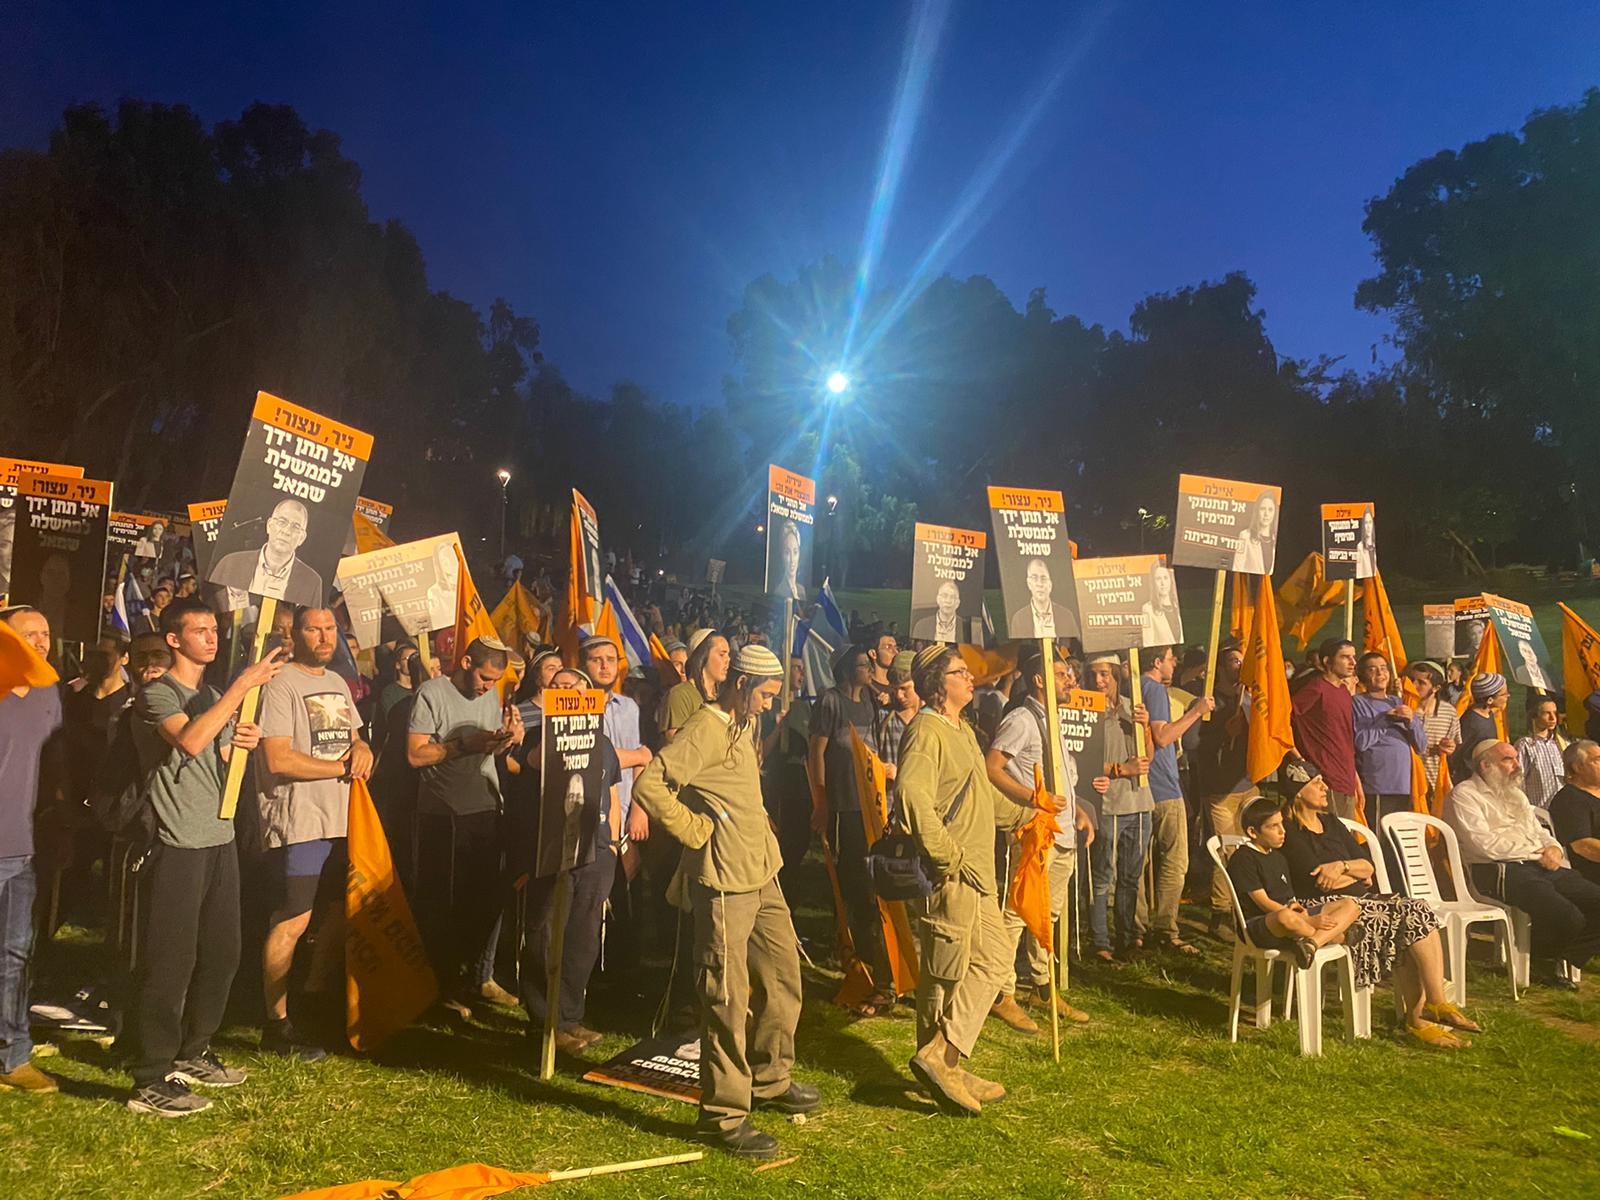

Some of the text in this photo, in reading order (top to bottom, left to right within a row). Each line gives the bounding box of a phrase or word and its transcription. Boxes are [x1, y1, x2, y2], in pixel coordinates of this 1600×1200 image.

[274, 407, 355, 450] ניר, עצור!
[262, 423, 356, 472] אל תתן ידך
[263, 447, 343, 488] לממשלת
[32, 479, 96, 499] ניר, עצור!
[272, 469, 326, 503] שמאל
[1203, 482, 1234, 497] איילת
[25, 496, 47, 512] ידך
[51, 499, 77, 515] תתן
[1001, 493, 1052, 509] ניר, עצור!
[1188, 495, 1246, 513] אל תתנתקי
[80, 501, 100, 518] אל
[201, 504, 226, 517] צור!
[998, 509, 1060, 525] אל תתן ידך
[30, 513, 91, 535] לממשלת
[109, 521, 134, 529] תתנתק
[199, 519, 218, 532] ידך
[1196, 510, 1236, 526] מהימין!
[927, 530, 975, 544] ניר, עצור!
[1007, 523, 1056, 540] לממשלת
[1183, 530, 1219, 546] הביתה
[922, 541, 980, 558] אל תתן ידך
[1017, 540, 1051, 556] שמאל
[927, 553, 973, 569] לממשלת
[1097, 562, 1126, 575] איילת
[351, 560, 425, 589] אל תתנתקי
[934, 566, 965, 581] שמאל
[368, 578, 418, 599] מהימ!
[1084, 575, 1142, 593] אל תתנתקי
[1096, 591, 1135, 607] מהימין!
[1088, 614, 1122, 626] הביתה
[555, 697, 596, 713] ניר, עצור!
[1074, 695, 1093, 708] ניר,
[551, 713, 599, 735] אל תתן ידך
[1082, 709, 1098, 723] אל
[318, 731, 335, 741] NEW
[1061, 723, 1092, 738] לממש
[556, 730, 595, 752] לממשלת
[1065, 739, 1084, 752] שמ
[562, 753, 590, 770] שמאל
